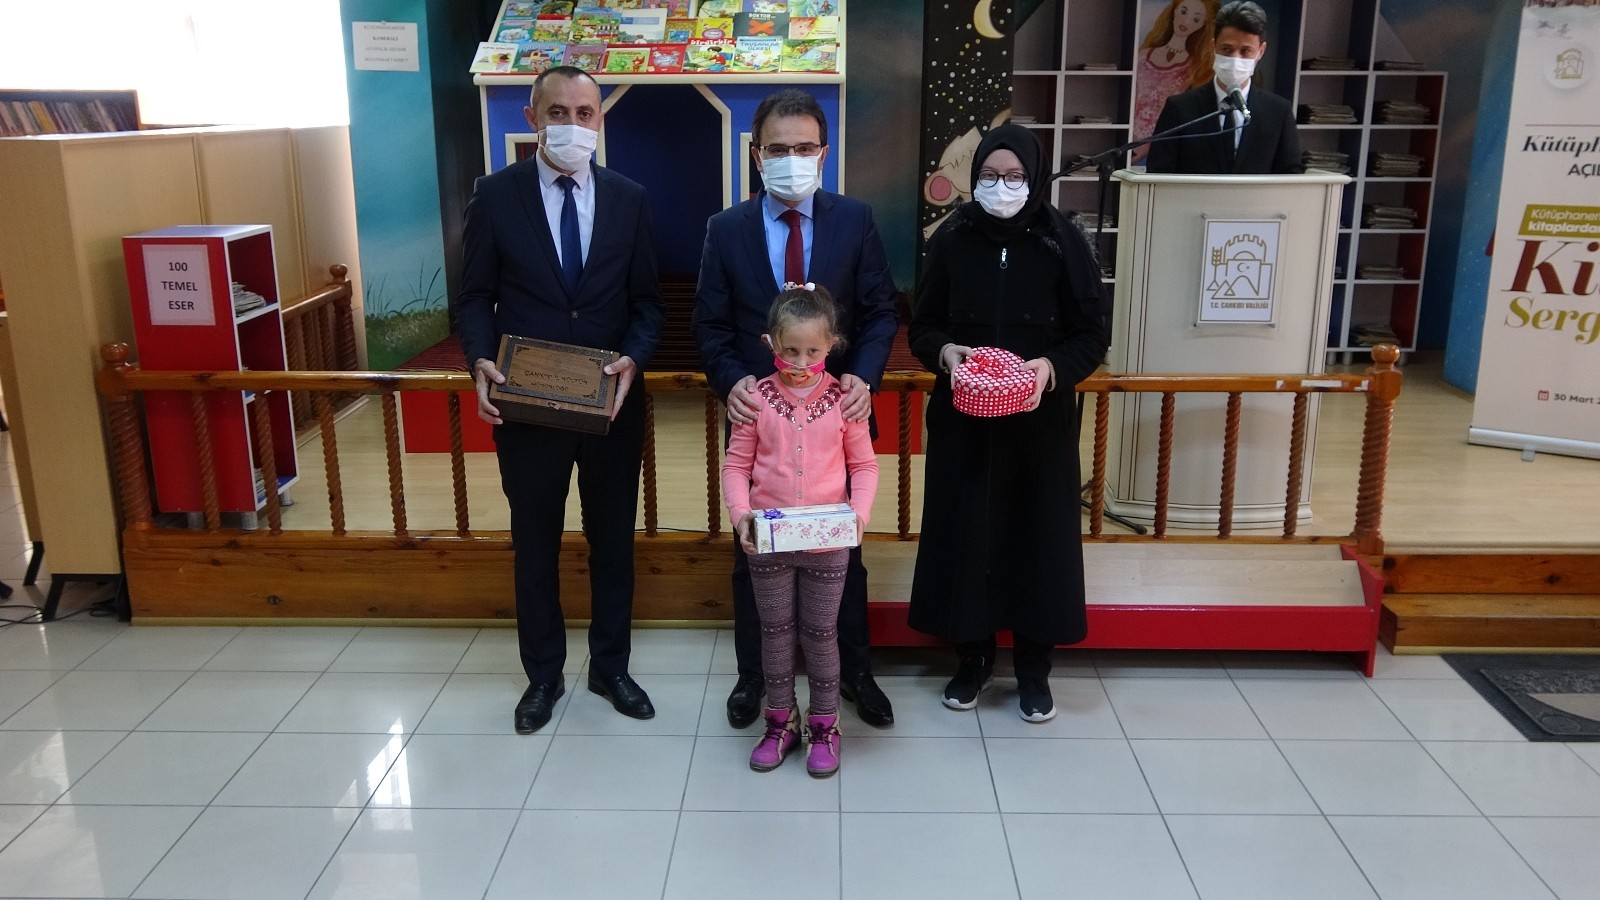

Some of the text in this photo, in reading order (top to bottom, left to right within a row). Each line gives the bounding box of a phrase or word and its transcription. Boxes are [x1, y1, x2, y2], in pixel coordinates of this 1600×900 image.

[168, 262, 188, 271] 100
[161, 280, 198, 291] TEMEL
[168, 300, 195, 311] ESER
[1554, 393, 1567, 401] 30
[1569, 394, 1594, 405] Mart
